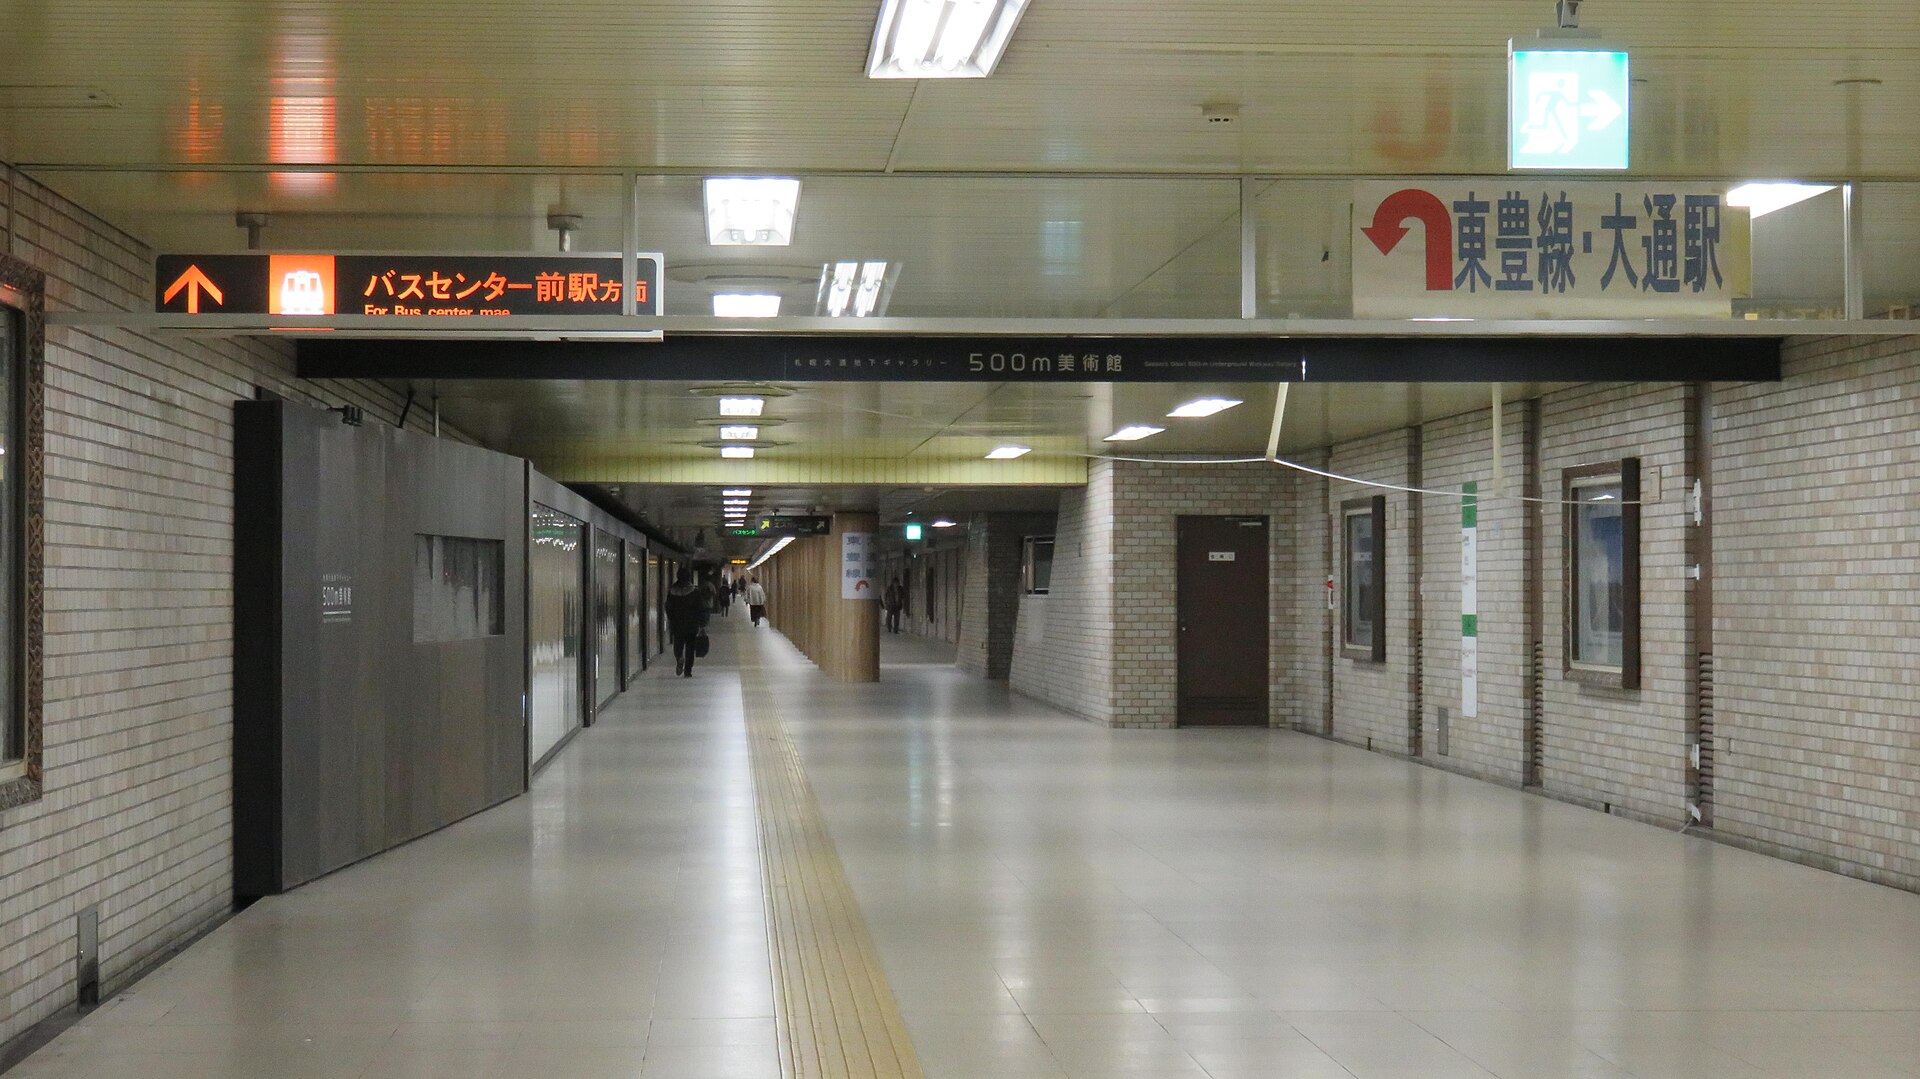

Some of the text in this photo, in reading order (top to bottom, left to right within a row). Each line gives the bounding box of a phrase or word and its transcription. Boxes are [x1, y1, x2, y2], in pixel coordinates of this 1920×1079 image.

[364, 304, 388, 315] For
[394, 304, 421, 315] Bus
[428, 307, 473, 315] center
[969, 353, 1122, 372] 500m美術館
